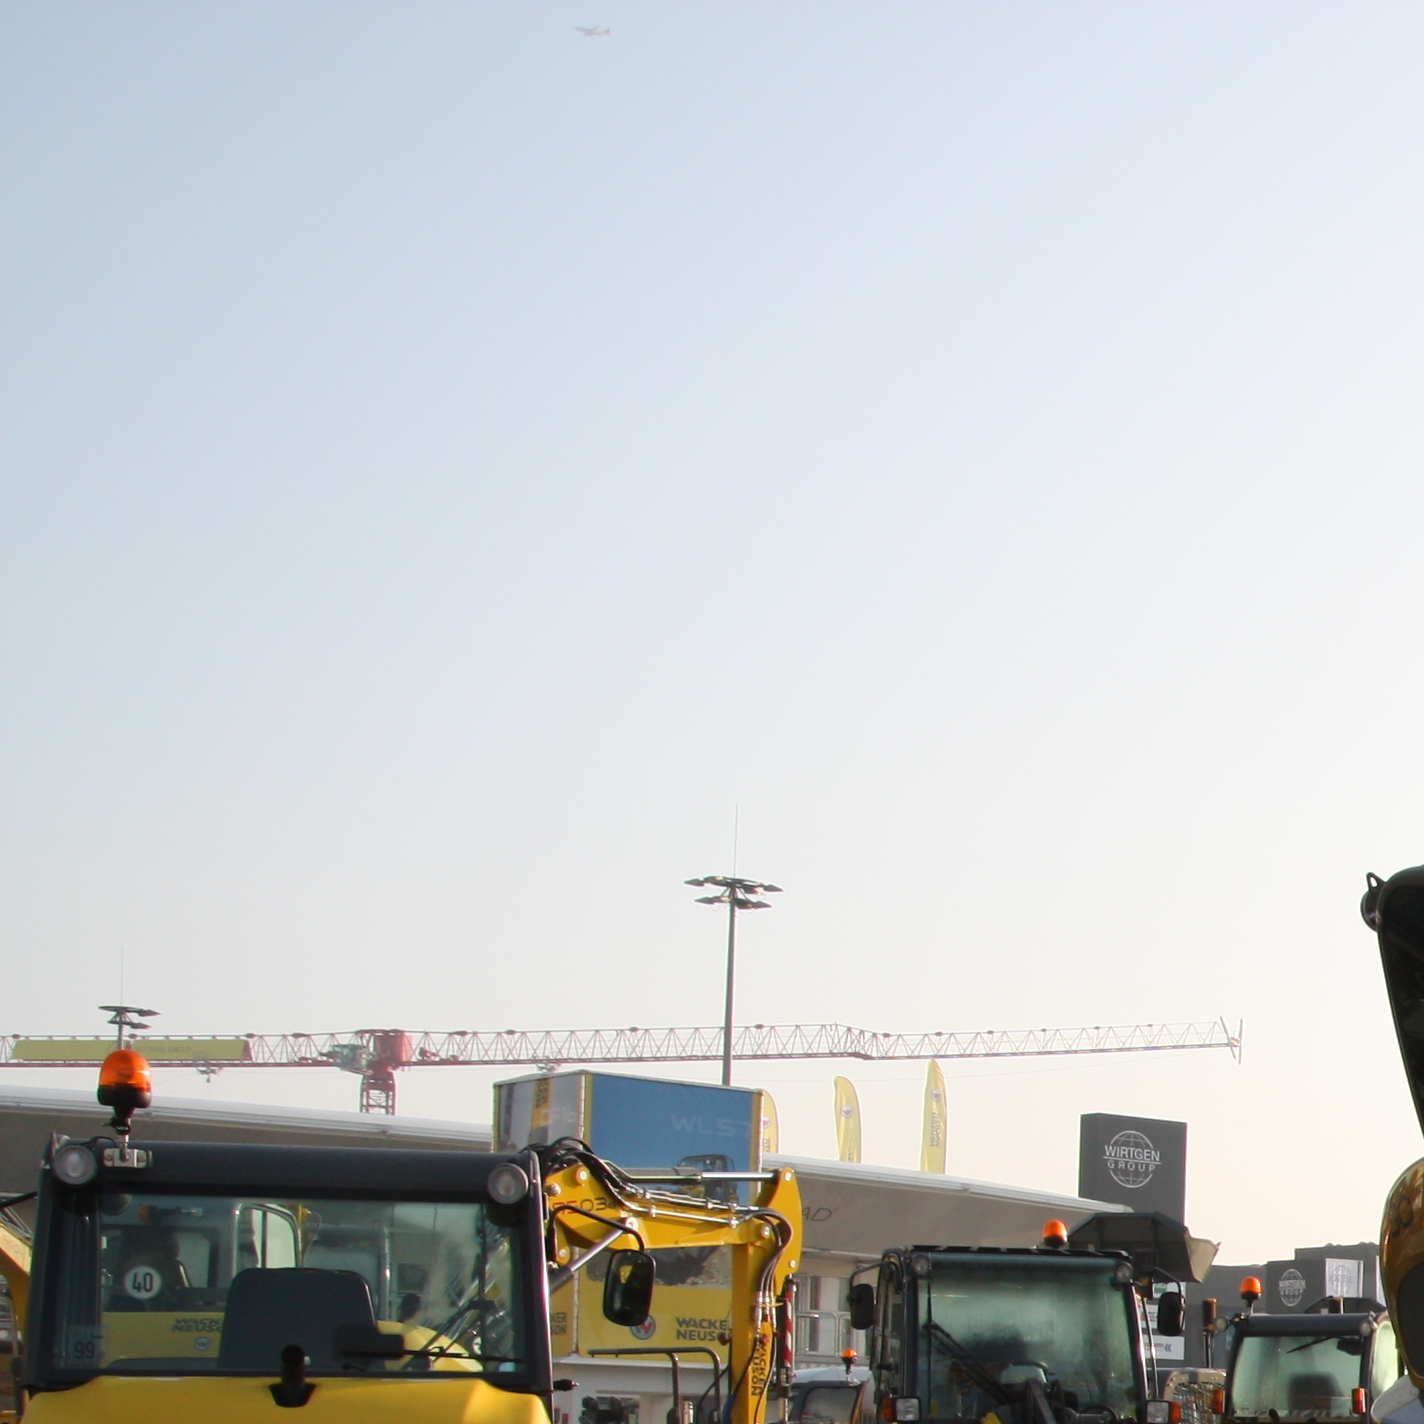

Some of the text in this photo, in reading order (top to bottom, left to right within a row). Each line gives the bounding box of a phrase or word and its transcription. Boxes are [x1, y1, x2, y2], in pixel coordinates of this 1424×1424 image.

[1104, 1144, 1161, 1162] WIRTGEN
[1107, 1159, 1156, 1172] GROUP
[132, 1272, 154, 1293] 40
[675, 1316, 730, 1331] WACKE
[676, 1329, 731, 1342] NEUS
